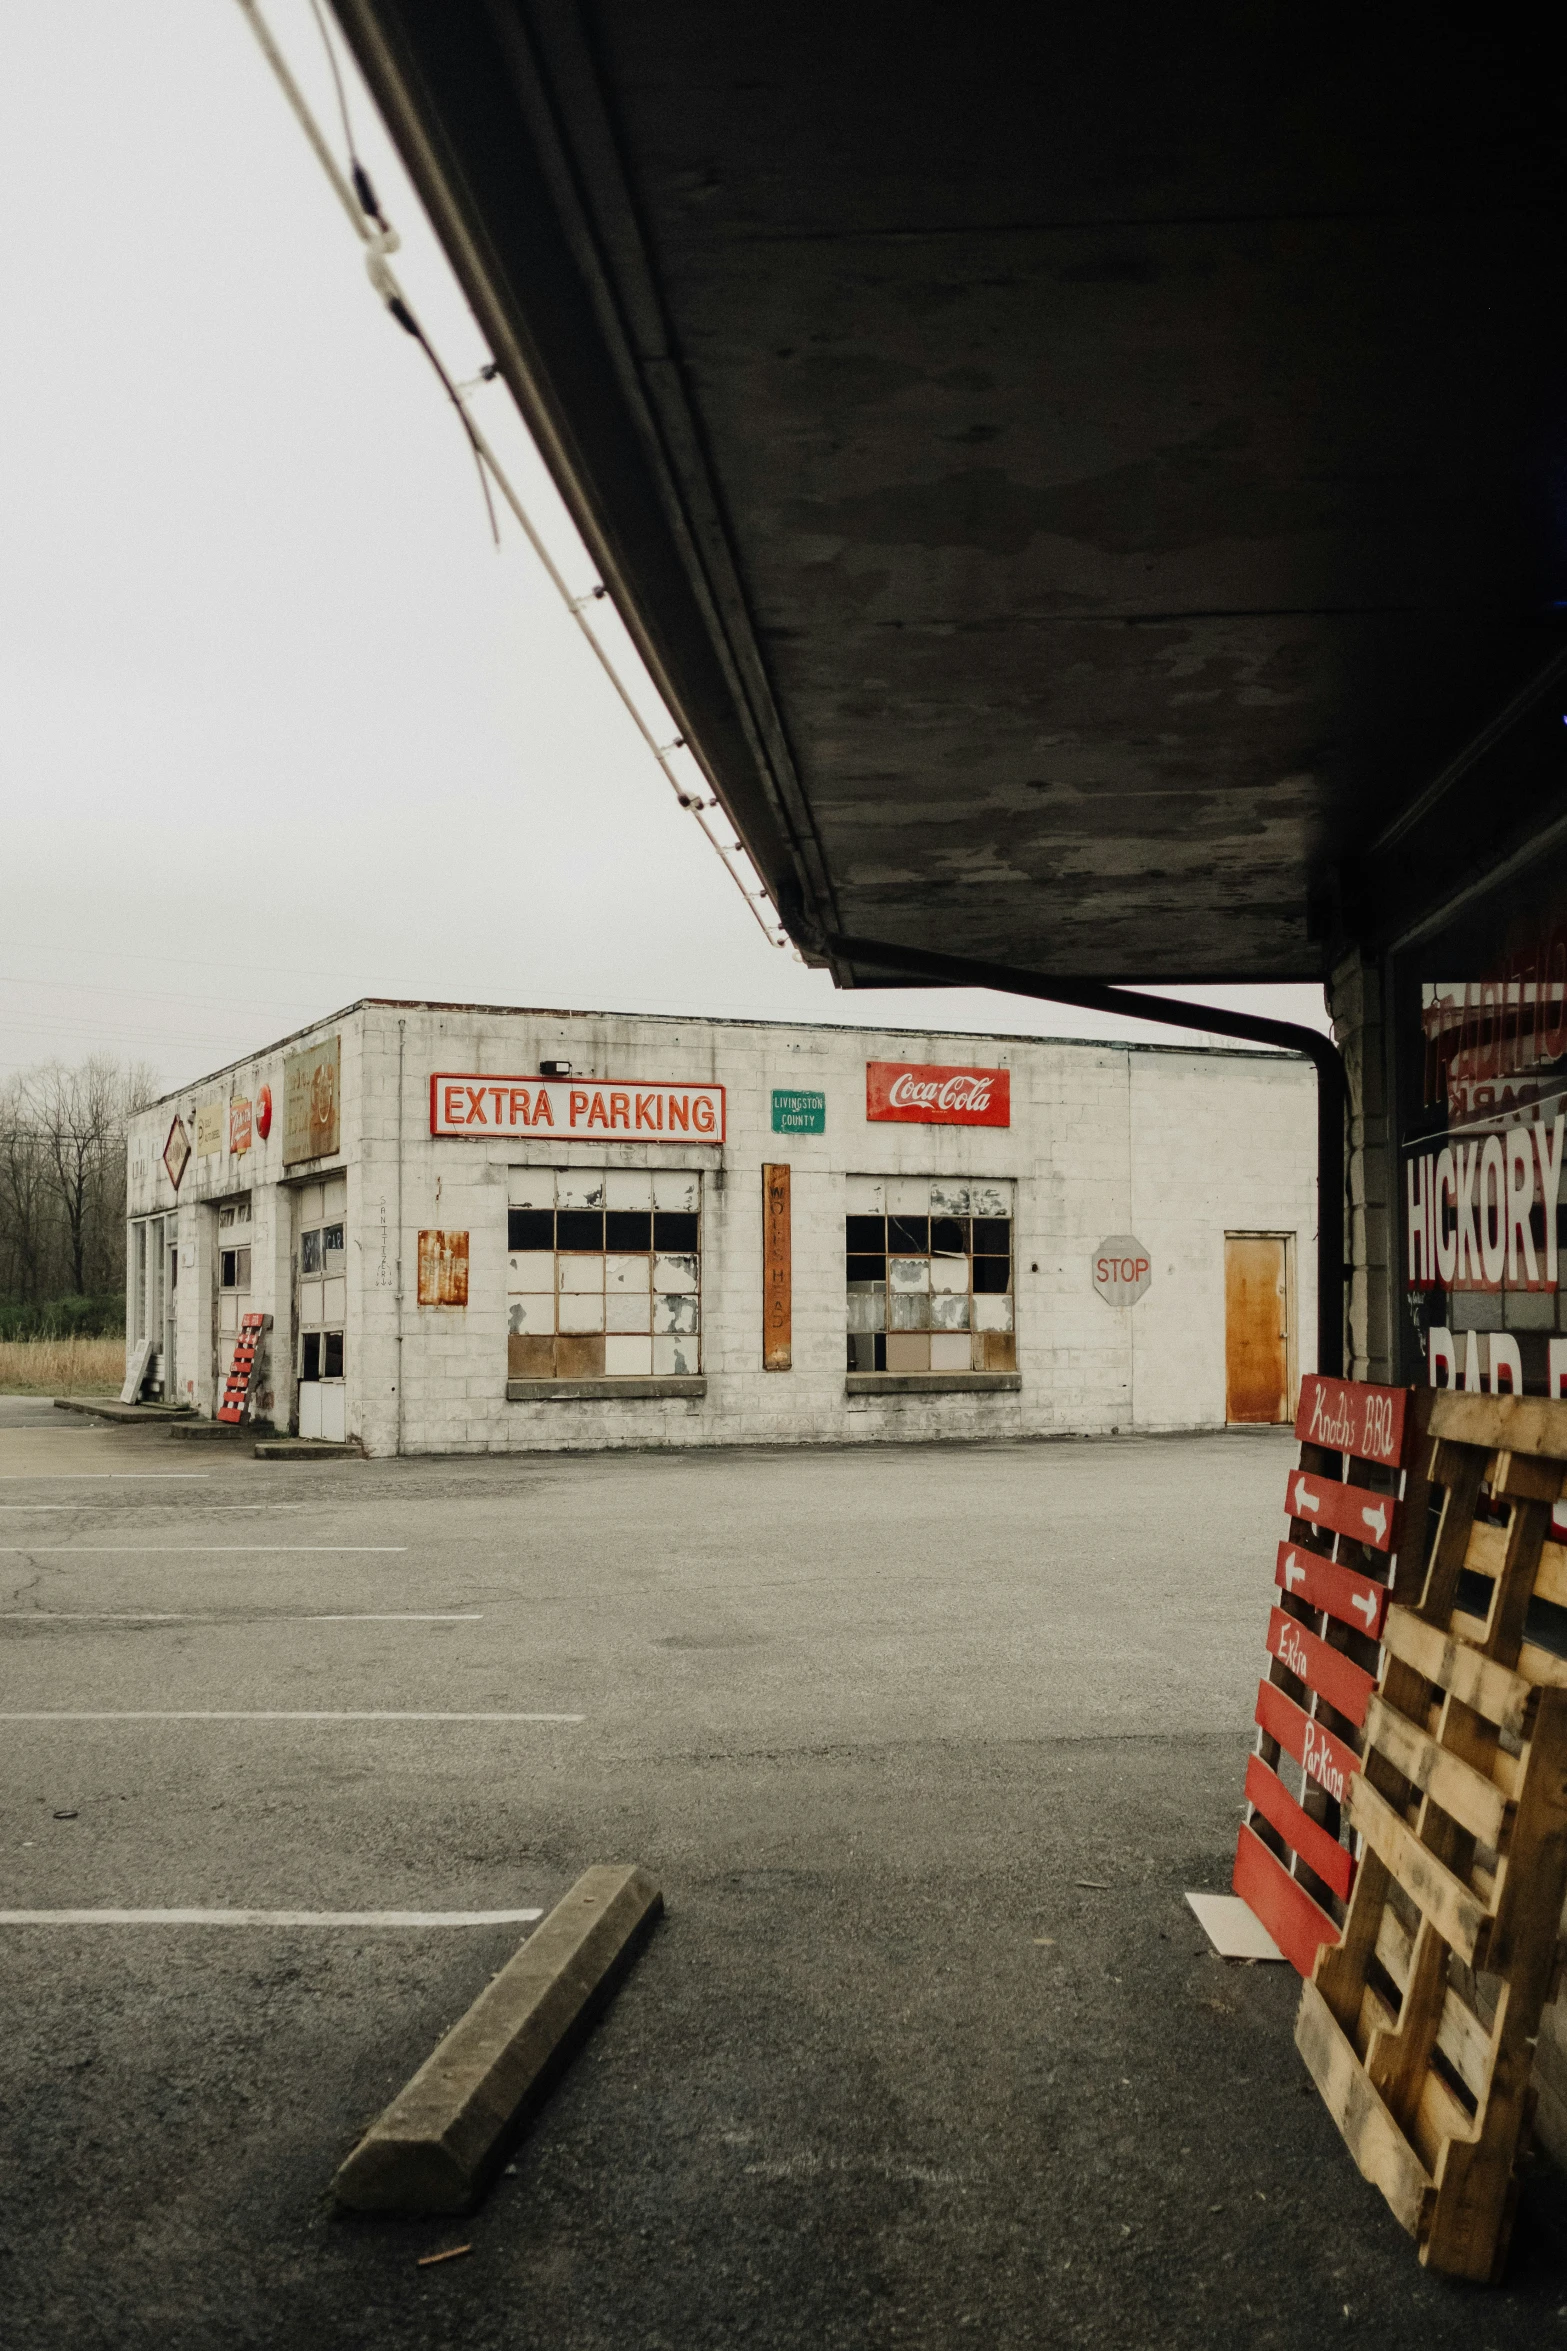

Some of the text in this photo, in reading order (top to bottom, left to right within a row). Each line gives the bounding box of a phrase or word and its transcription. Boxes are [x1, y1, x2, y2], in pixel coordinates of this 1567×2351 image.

[444, 1086, 715, 1132] EXTRA PARKING
[773, 1096, 824, 1110] LIVINGSTON
[889, 1072, 994, 1111] Coca-Cola
[781, 1113, 816, 1127] COUNTY
[1407, 1114, 1566, 1285] HICKORY
[1096, 1257, 1149, 1283] STOP
[1361, 1394, 1395, 1458] BBQ
[1277, 1622, 1308, 1679] Extra
